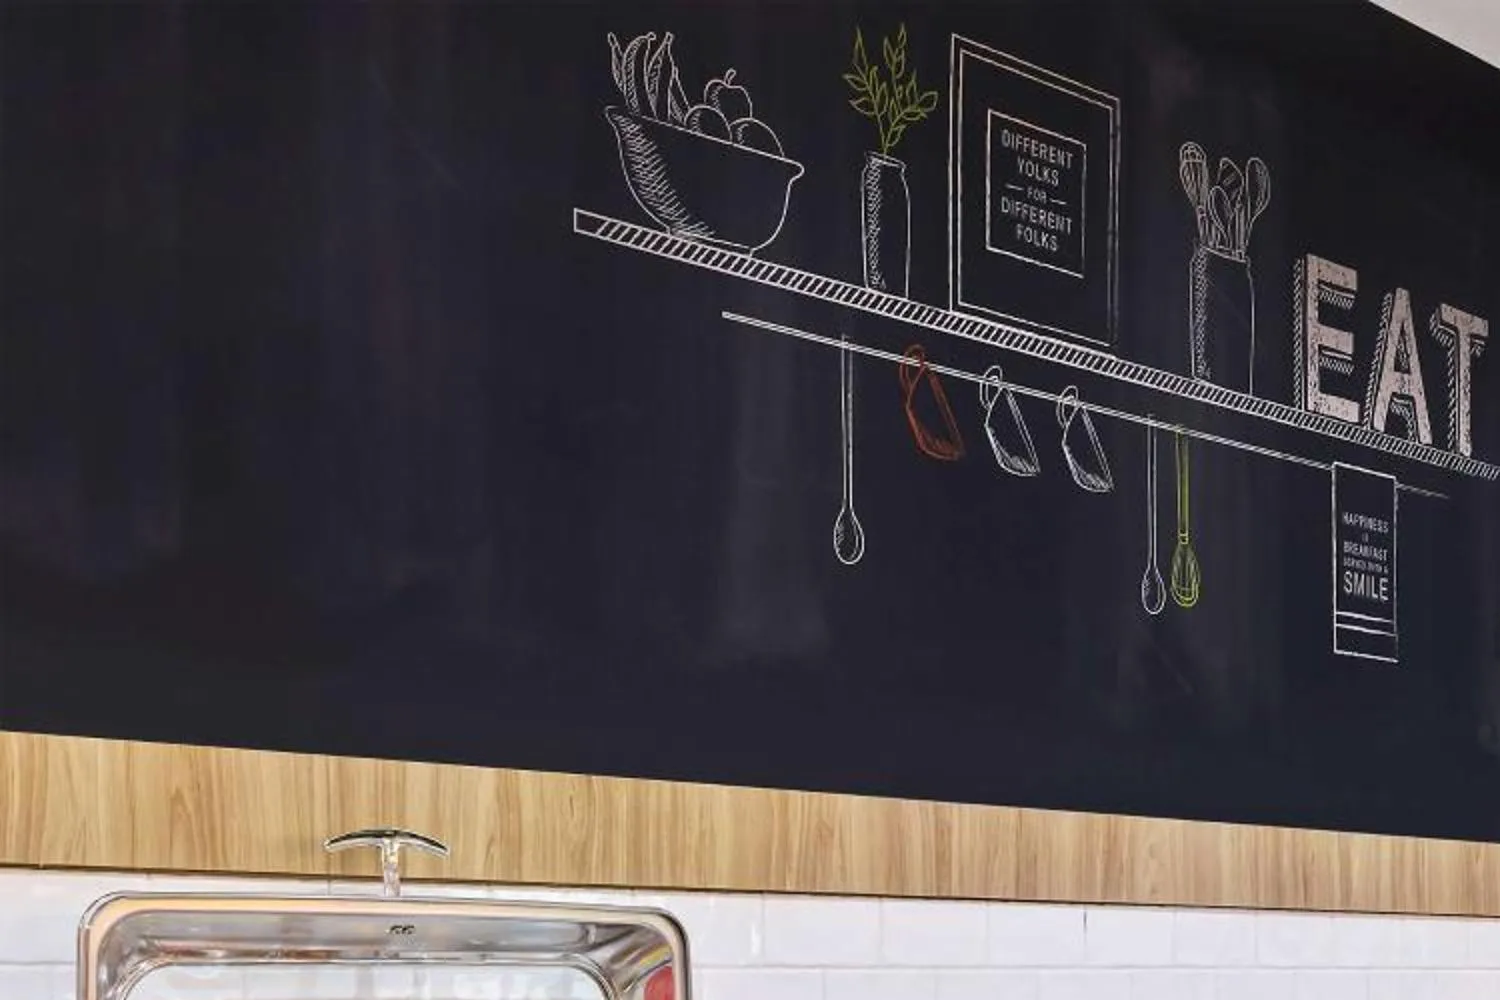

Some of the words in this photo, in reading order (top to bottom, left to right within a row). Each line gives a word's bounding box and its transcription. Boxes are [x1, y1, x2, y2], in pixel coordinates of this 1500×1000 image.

[1001, 129, 1073, 169] DIFFERENT
[1018, 156, 1059, 187] YOLKS
[1027, 185, 1047, 201] FOR
[1001, 196, 1072, 235] DIFFERENT
[1016, 223, 1058, 252] FOLKS
[1294, 253, 1489, 457] EAT
[1343, 512, 1389, 534] HAPPINESS
[1343, 571, 1389, 602] SMILE
